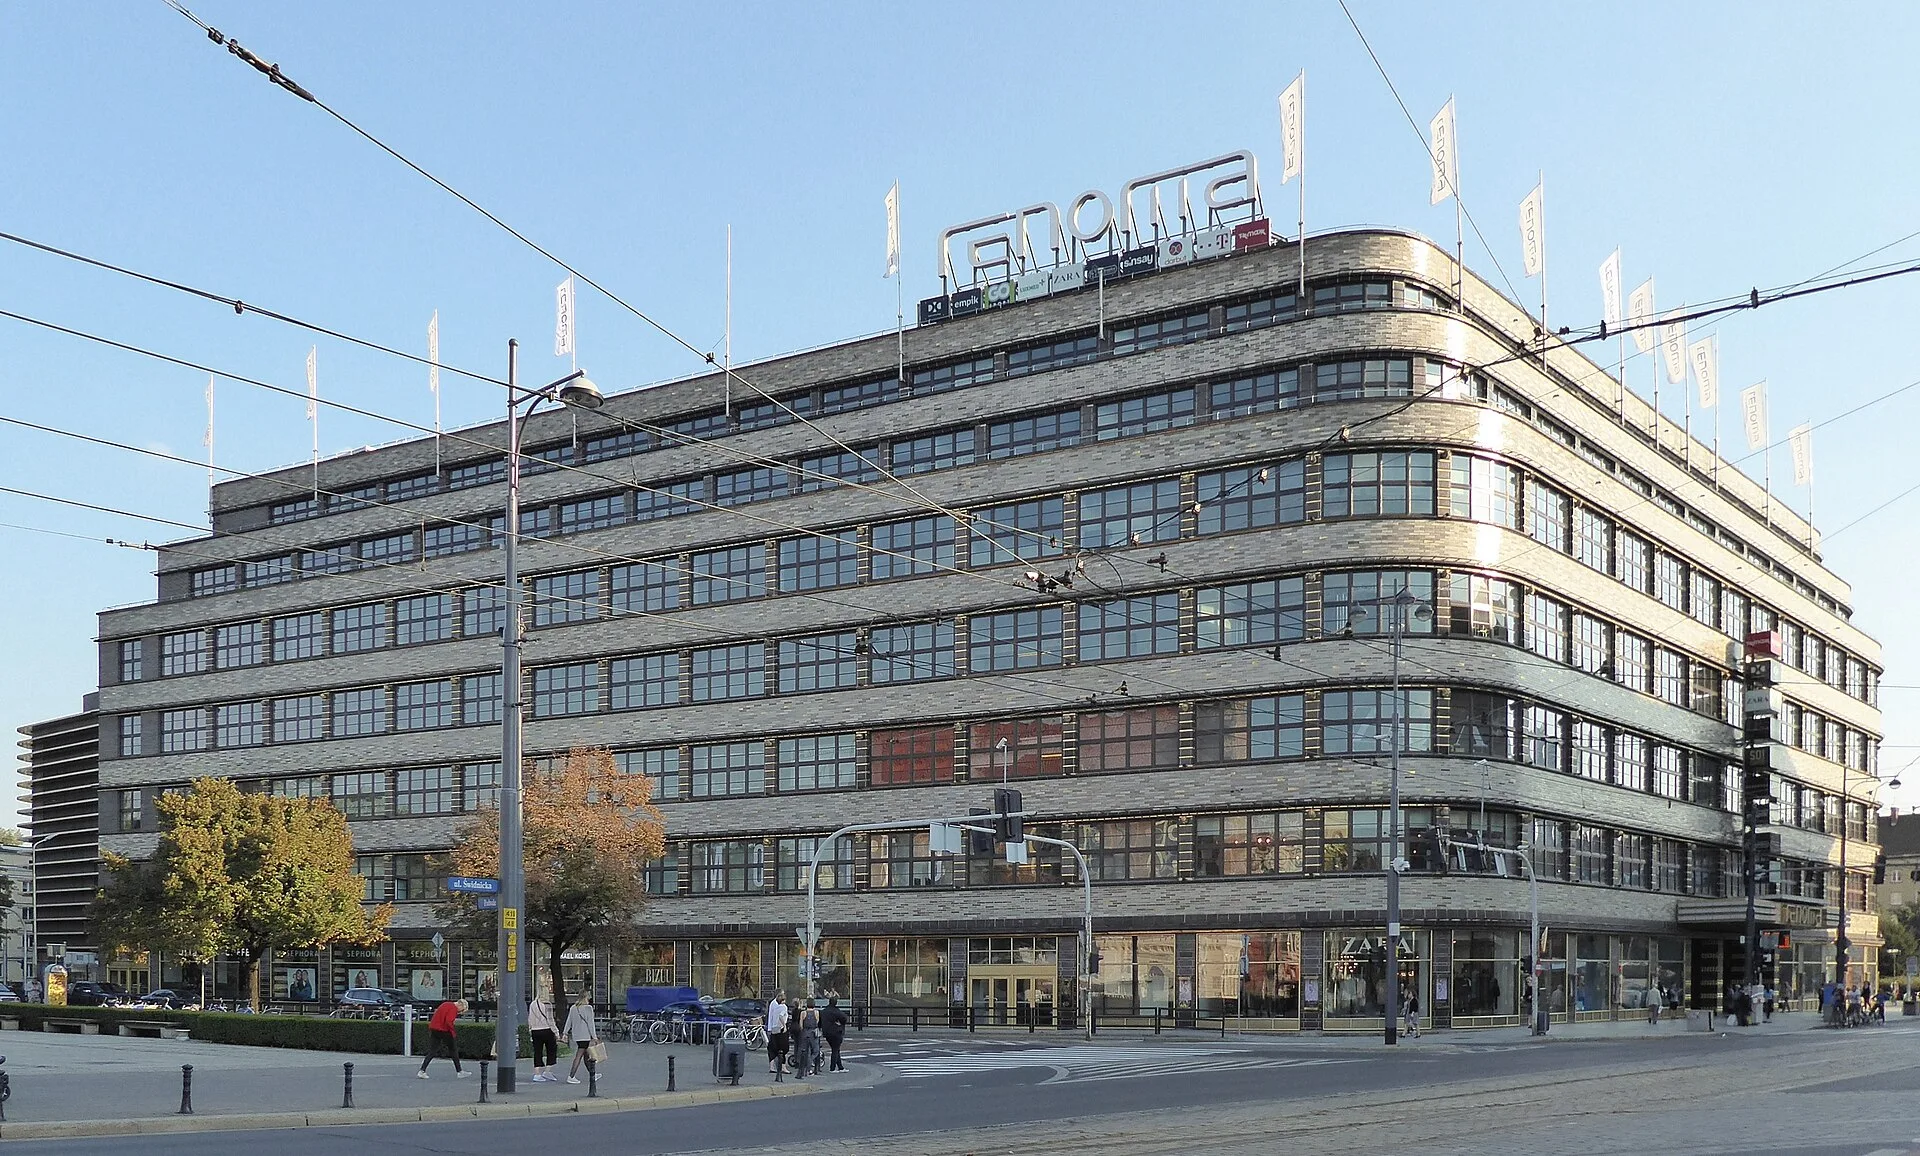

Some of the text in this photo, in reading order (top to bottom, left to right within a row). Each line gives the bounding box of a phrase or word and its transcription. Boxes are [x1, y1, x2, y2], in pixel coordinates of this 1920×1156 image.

[937, 149, 1258, 279] renoma
[1525, 200, 1537, 269] renoma
[1053, 271, 1081, 285] ZARA
[1123, 253, 1153, 269] sinsay
[954, 293, 979, 309] empik
[1667, 322, 1681, 376] enoma
[1696, 345, 1711, 402] renoma
[346, 950, 381, 958] SEPHORA
